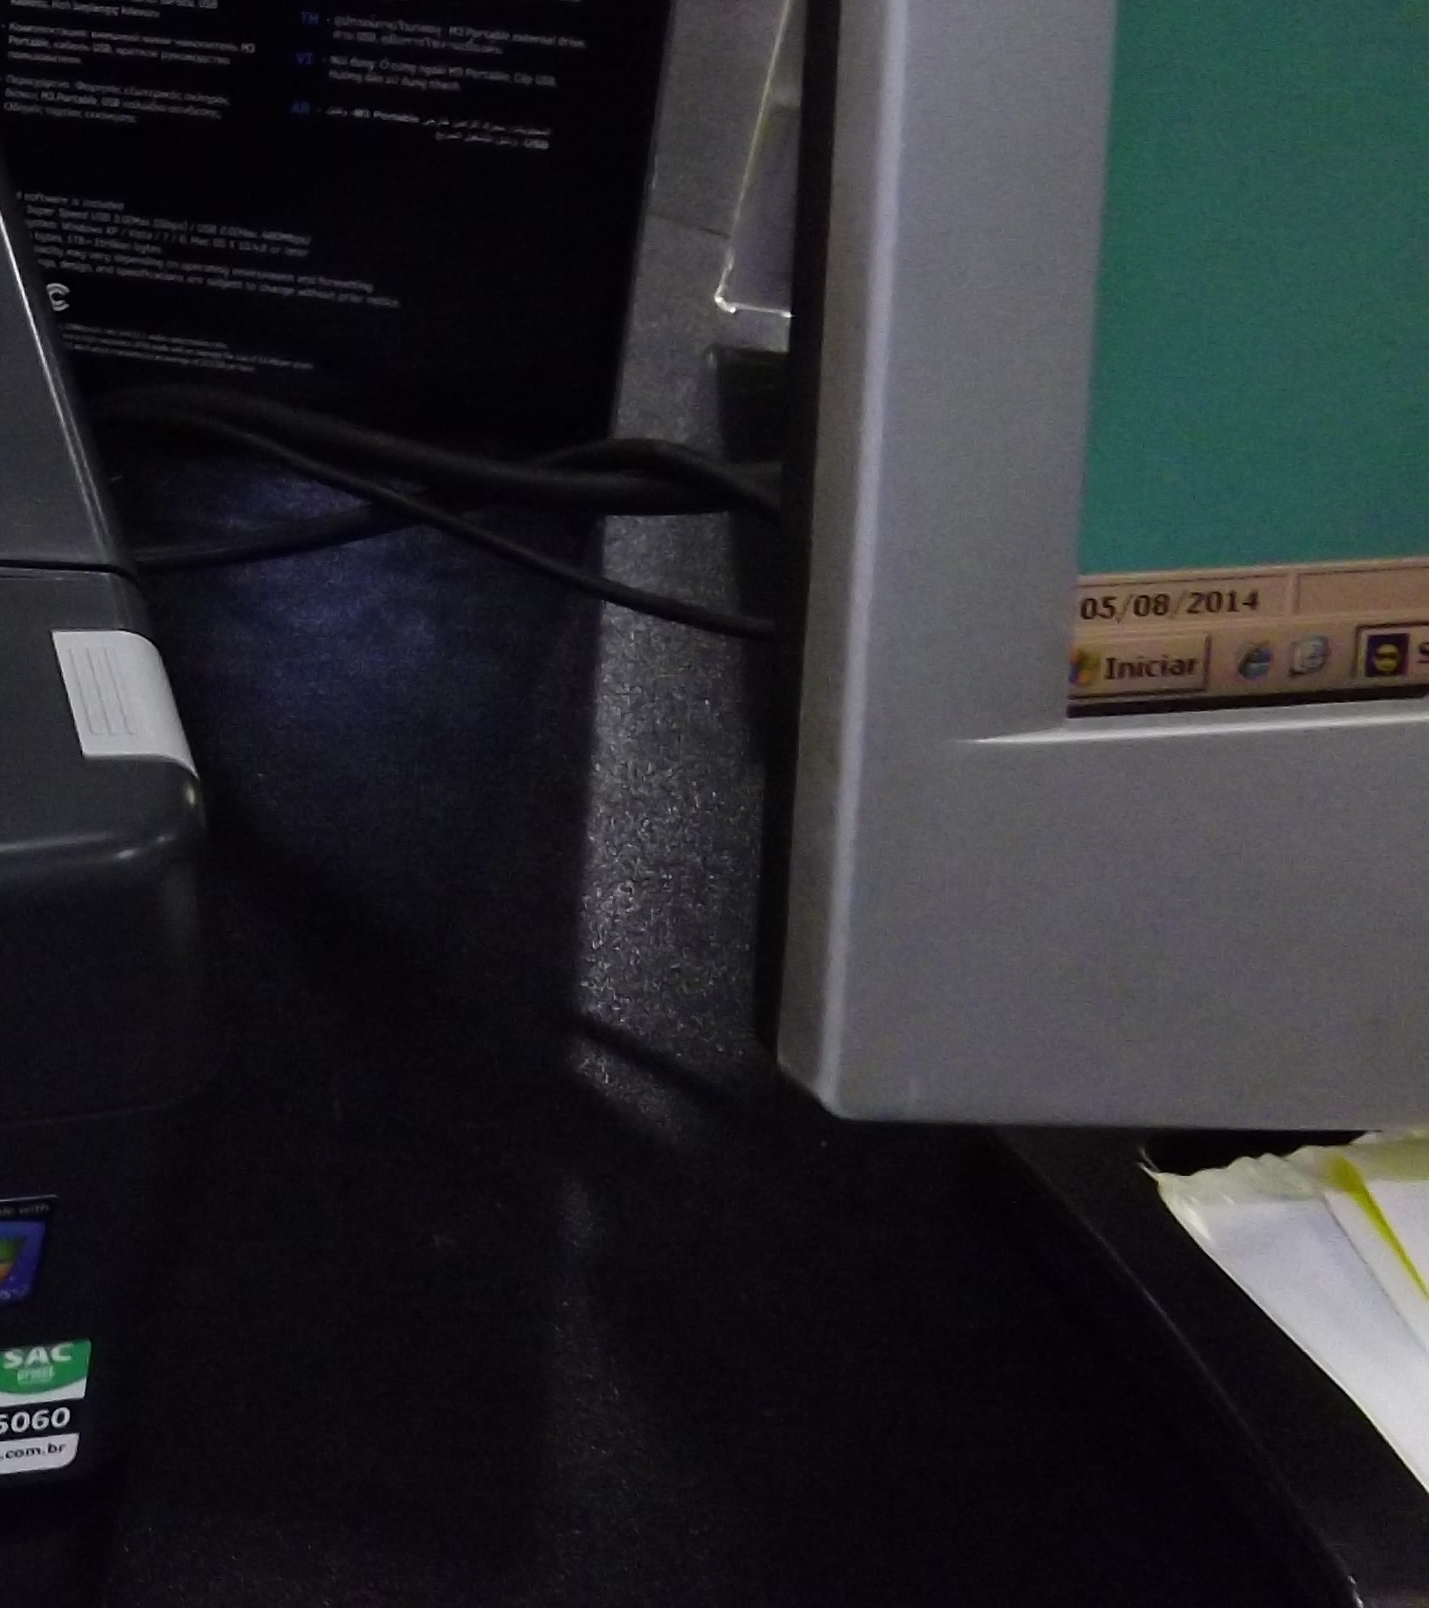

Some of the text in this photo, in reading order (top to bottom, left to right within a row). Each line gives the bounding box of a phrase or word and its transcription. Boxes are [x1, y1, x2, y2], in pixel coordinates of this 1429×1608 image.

[1080, 590, 1260, 622] 05/08/2014
[1105, 655, 1199, 681] Iniciar
[2, 1343, 74, 1369] SAC
